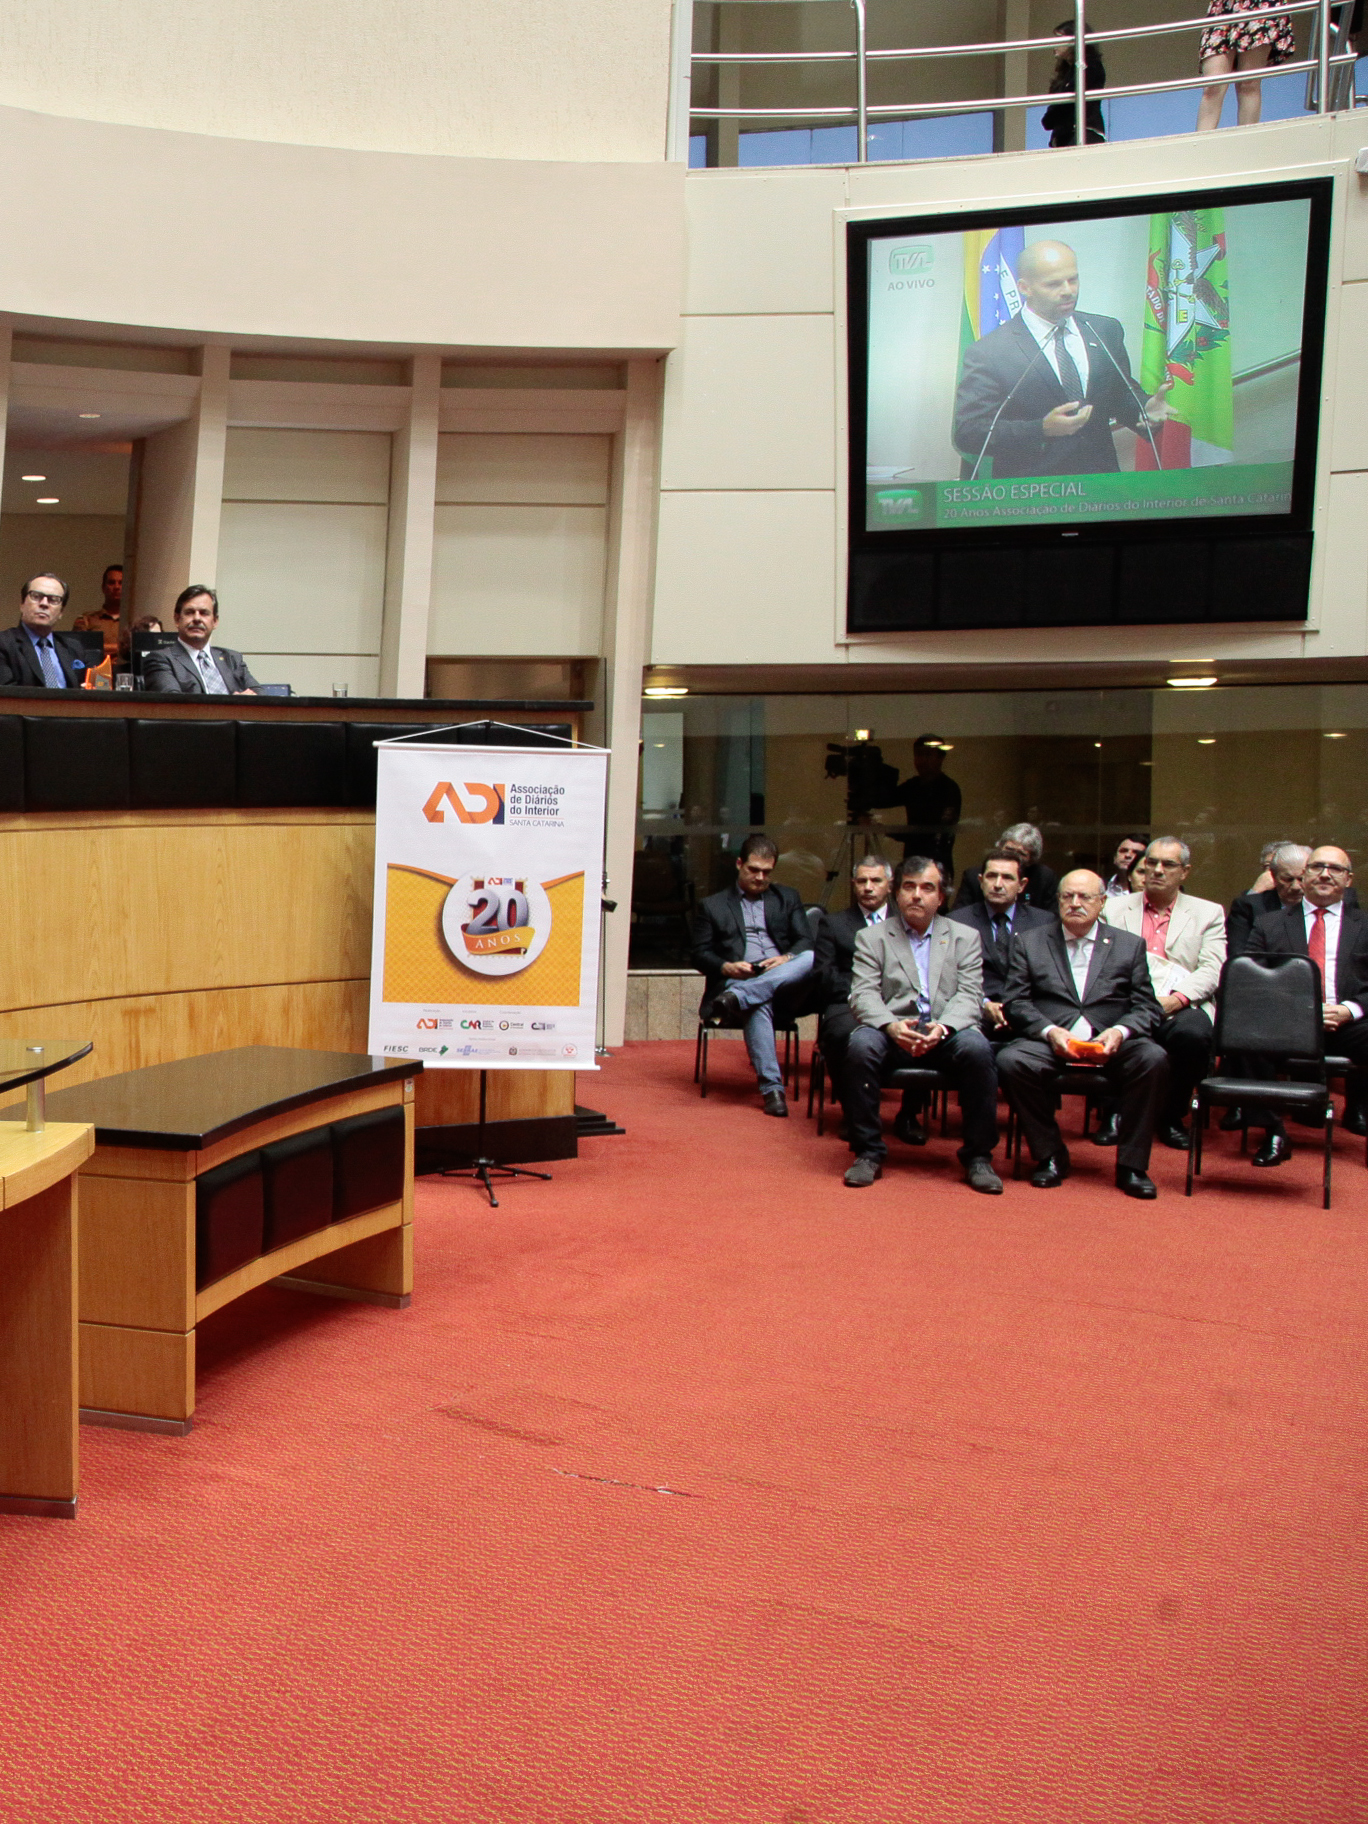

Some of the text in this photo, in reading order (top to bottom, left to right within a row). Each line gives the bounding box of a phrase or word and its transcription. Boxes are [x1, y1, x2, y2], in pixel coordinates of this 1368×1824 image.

[887, 278, 935, 291] AO VIVO
[943, 482, 1086, 502] SESSÃO ESPECIAL
[943, 508, 957, 518] 20
[960, 507, 989, 518] Anos
[992, 504, 1057, 517] Associação
[1060, 502, 1076, 513] de
[1078, 499, 1120, 513] Diários
[1123, 500, 1140, 510] do
[1143, 497, 1187, 509] Interior
[1190, 498, 1207, 507] de
[1210, 495, 1244, 505] Santa
[510, 784, 565, 797] Associação
[422, 781, 505, 825] ADI
[510, 794, 558, 806] de Diários
[510, 804, 559, 816] do Interior
[509, 819, 565, 828] SANTA CATARINA
[467, 888, 529, 935] 20
[475, 933, 521, 949] ANOS
[383, 1045, 409, 1053] FIESC
